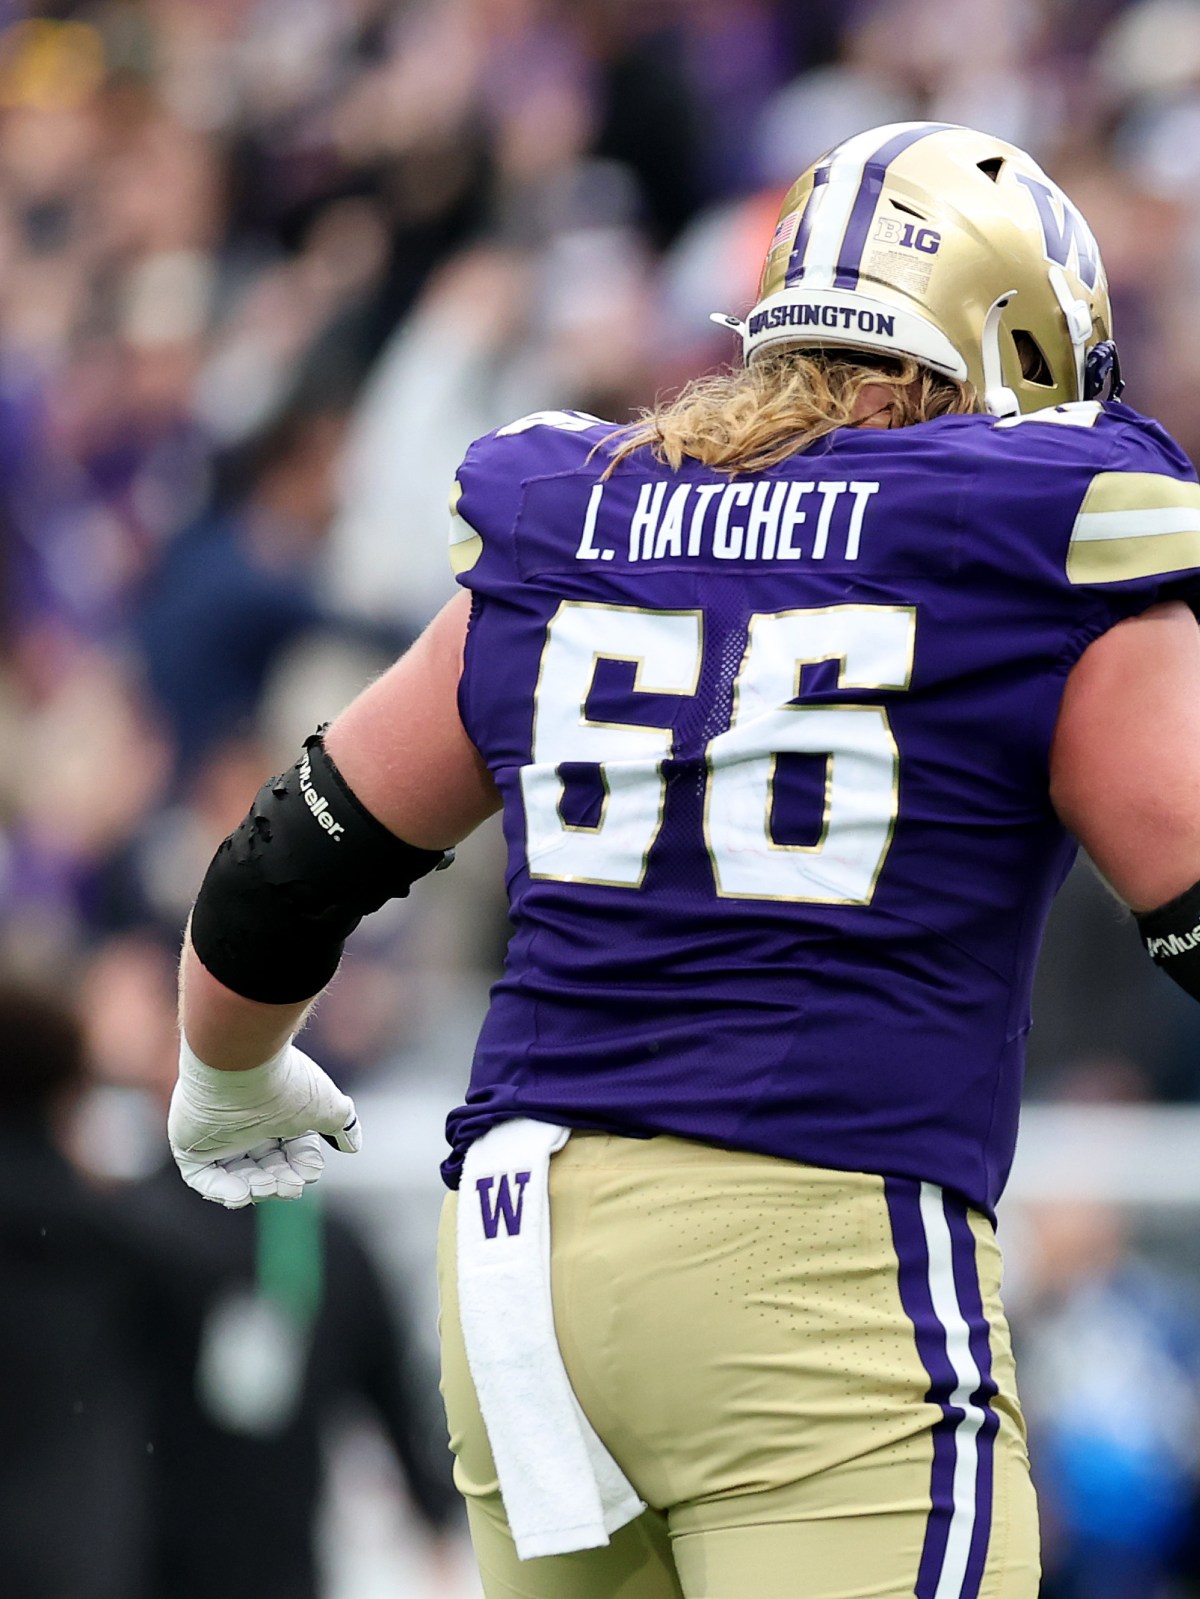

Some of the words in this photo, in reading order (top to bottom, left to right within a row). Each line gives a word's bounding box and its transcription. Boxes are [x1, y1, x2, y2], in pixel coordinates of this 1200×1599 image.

[749, 304, 895, 338] WASHINGTON
[575, 483, 616, 561] L.
[628, 481, 880, 562] HATCHETT
[519, 601, 918, 908] 66
[476, 1171, 531, 1239] W
